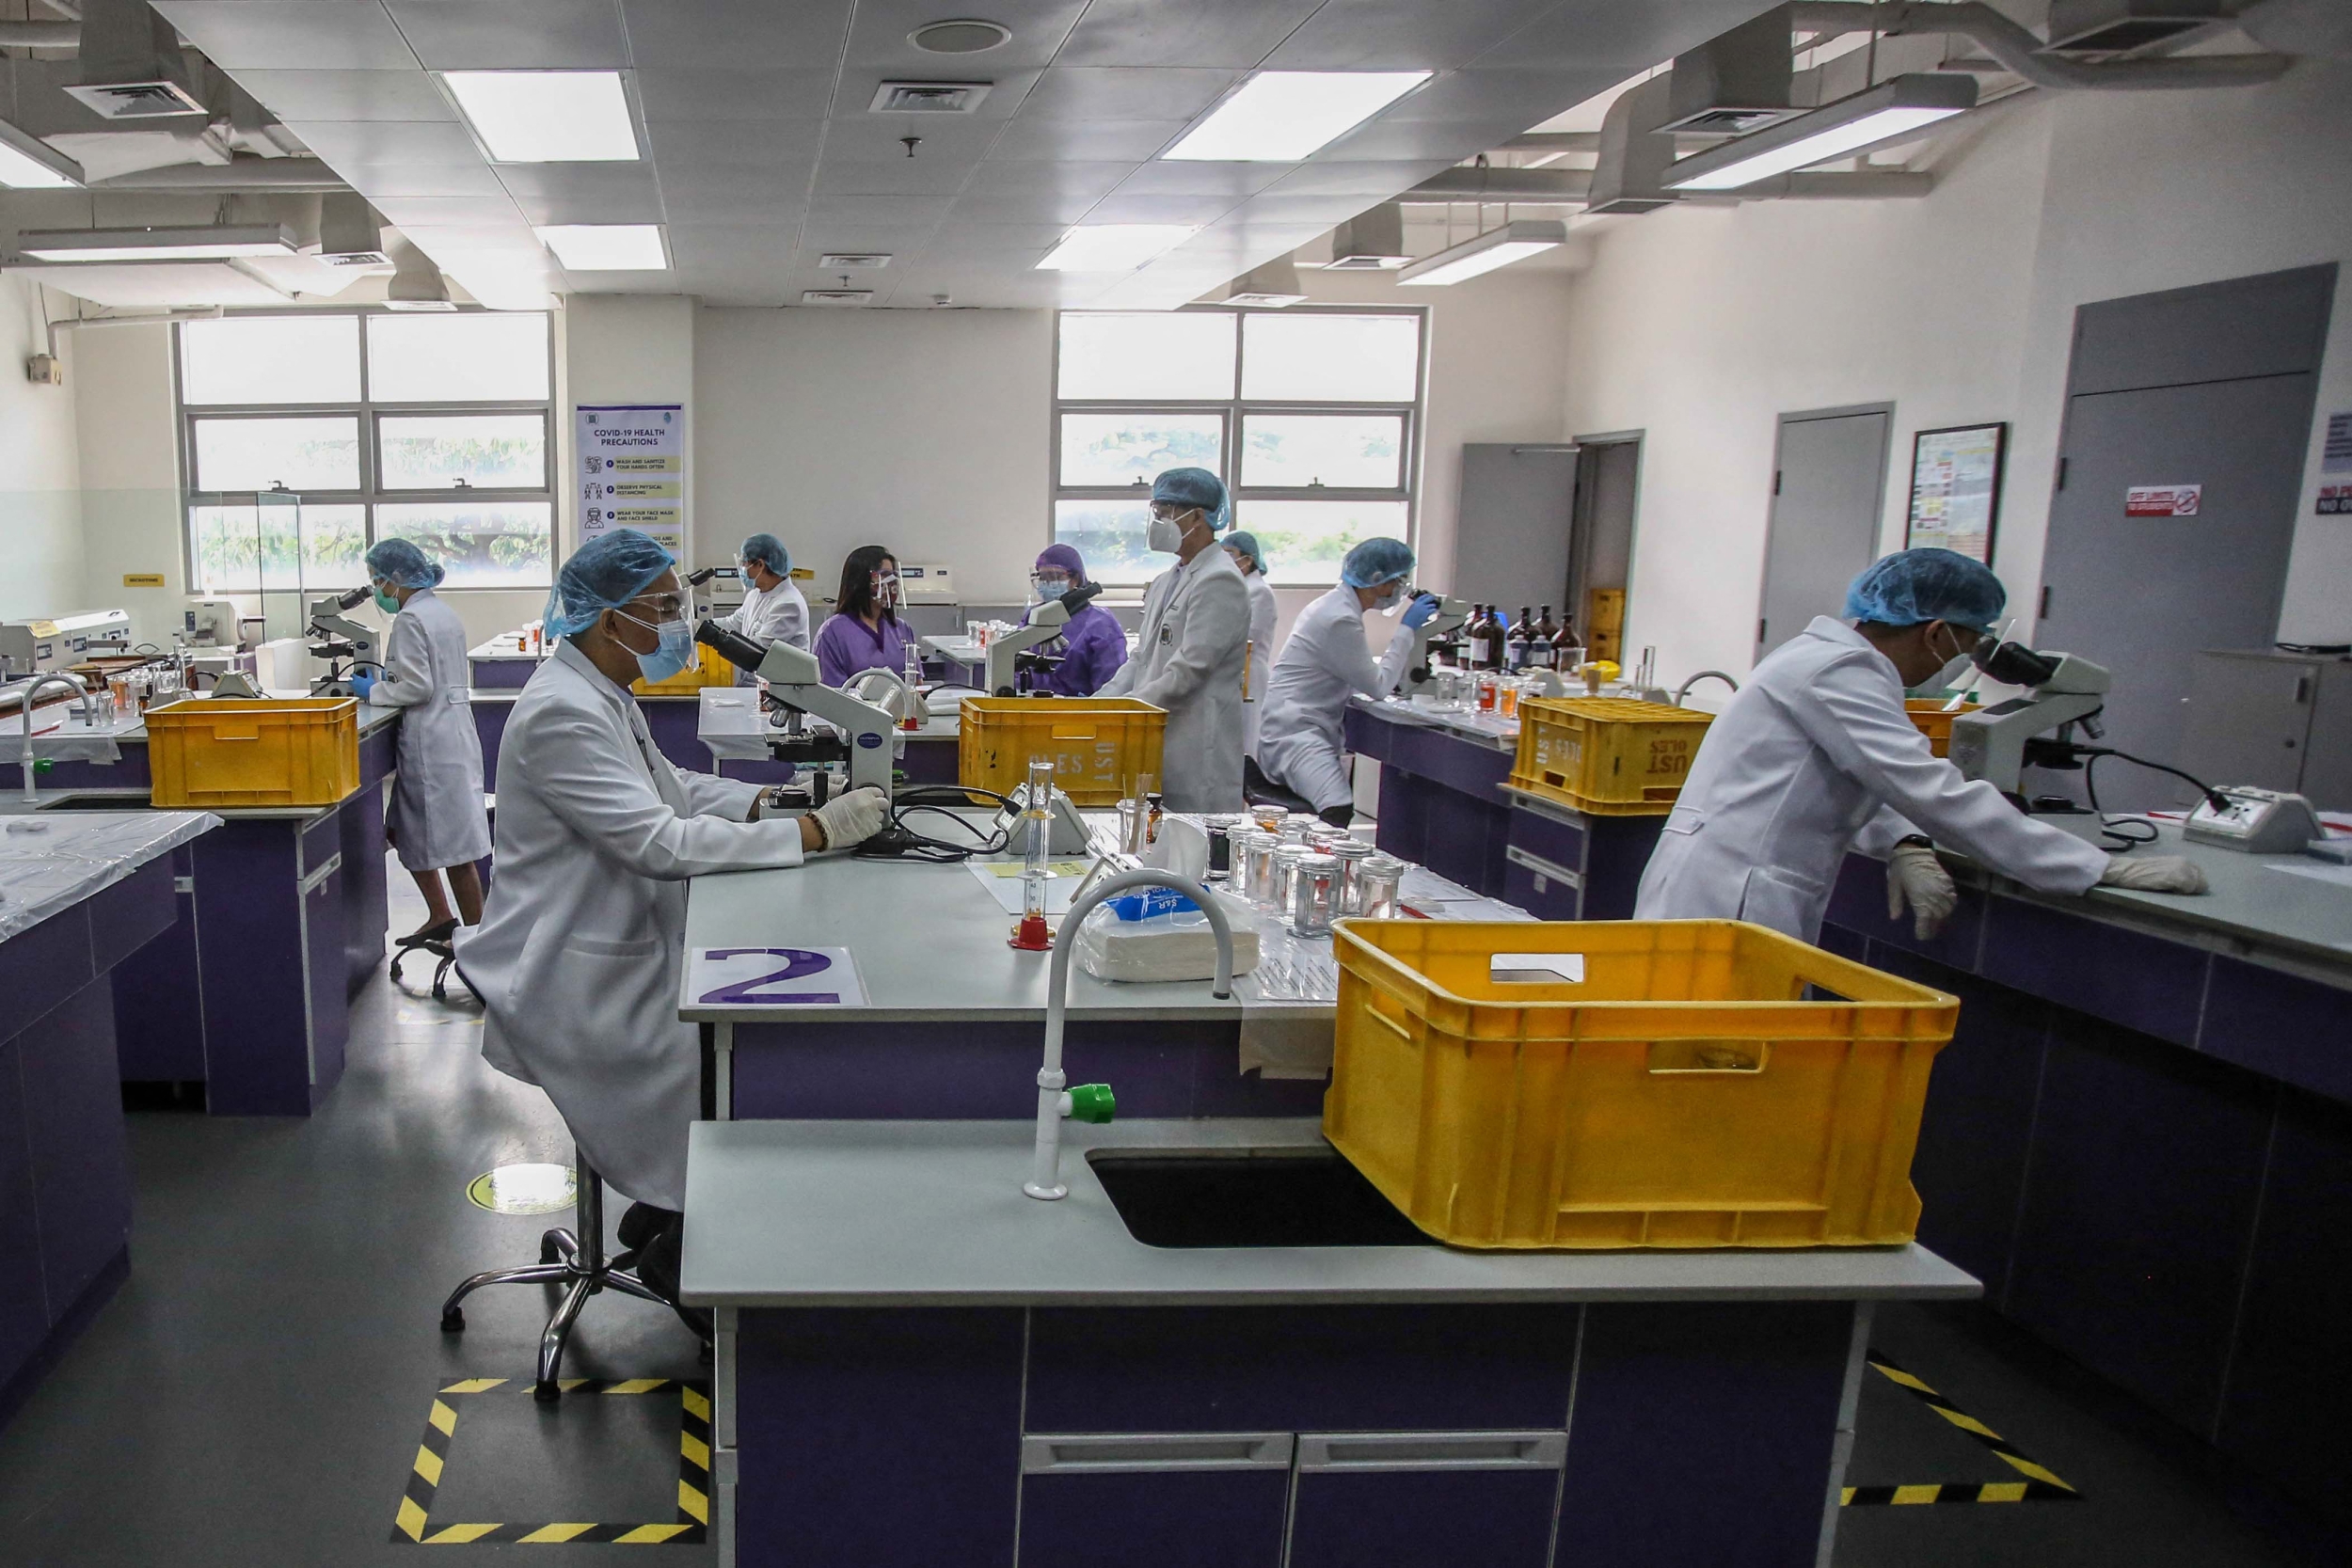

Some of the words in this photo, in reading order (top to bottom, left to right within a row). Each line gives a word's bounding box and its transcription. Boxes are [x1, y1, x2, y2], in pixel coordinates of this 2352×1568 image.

[594, 429, 632, 437] COVID-19
[1646, 755, 1688, 774] UST
[1158, 898, 1177, 910] S&R
[699, 949, 840, 1004] 2
